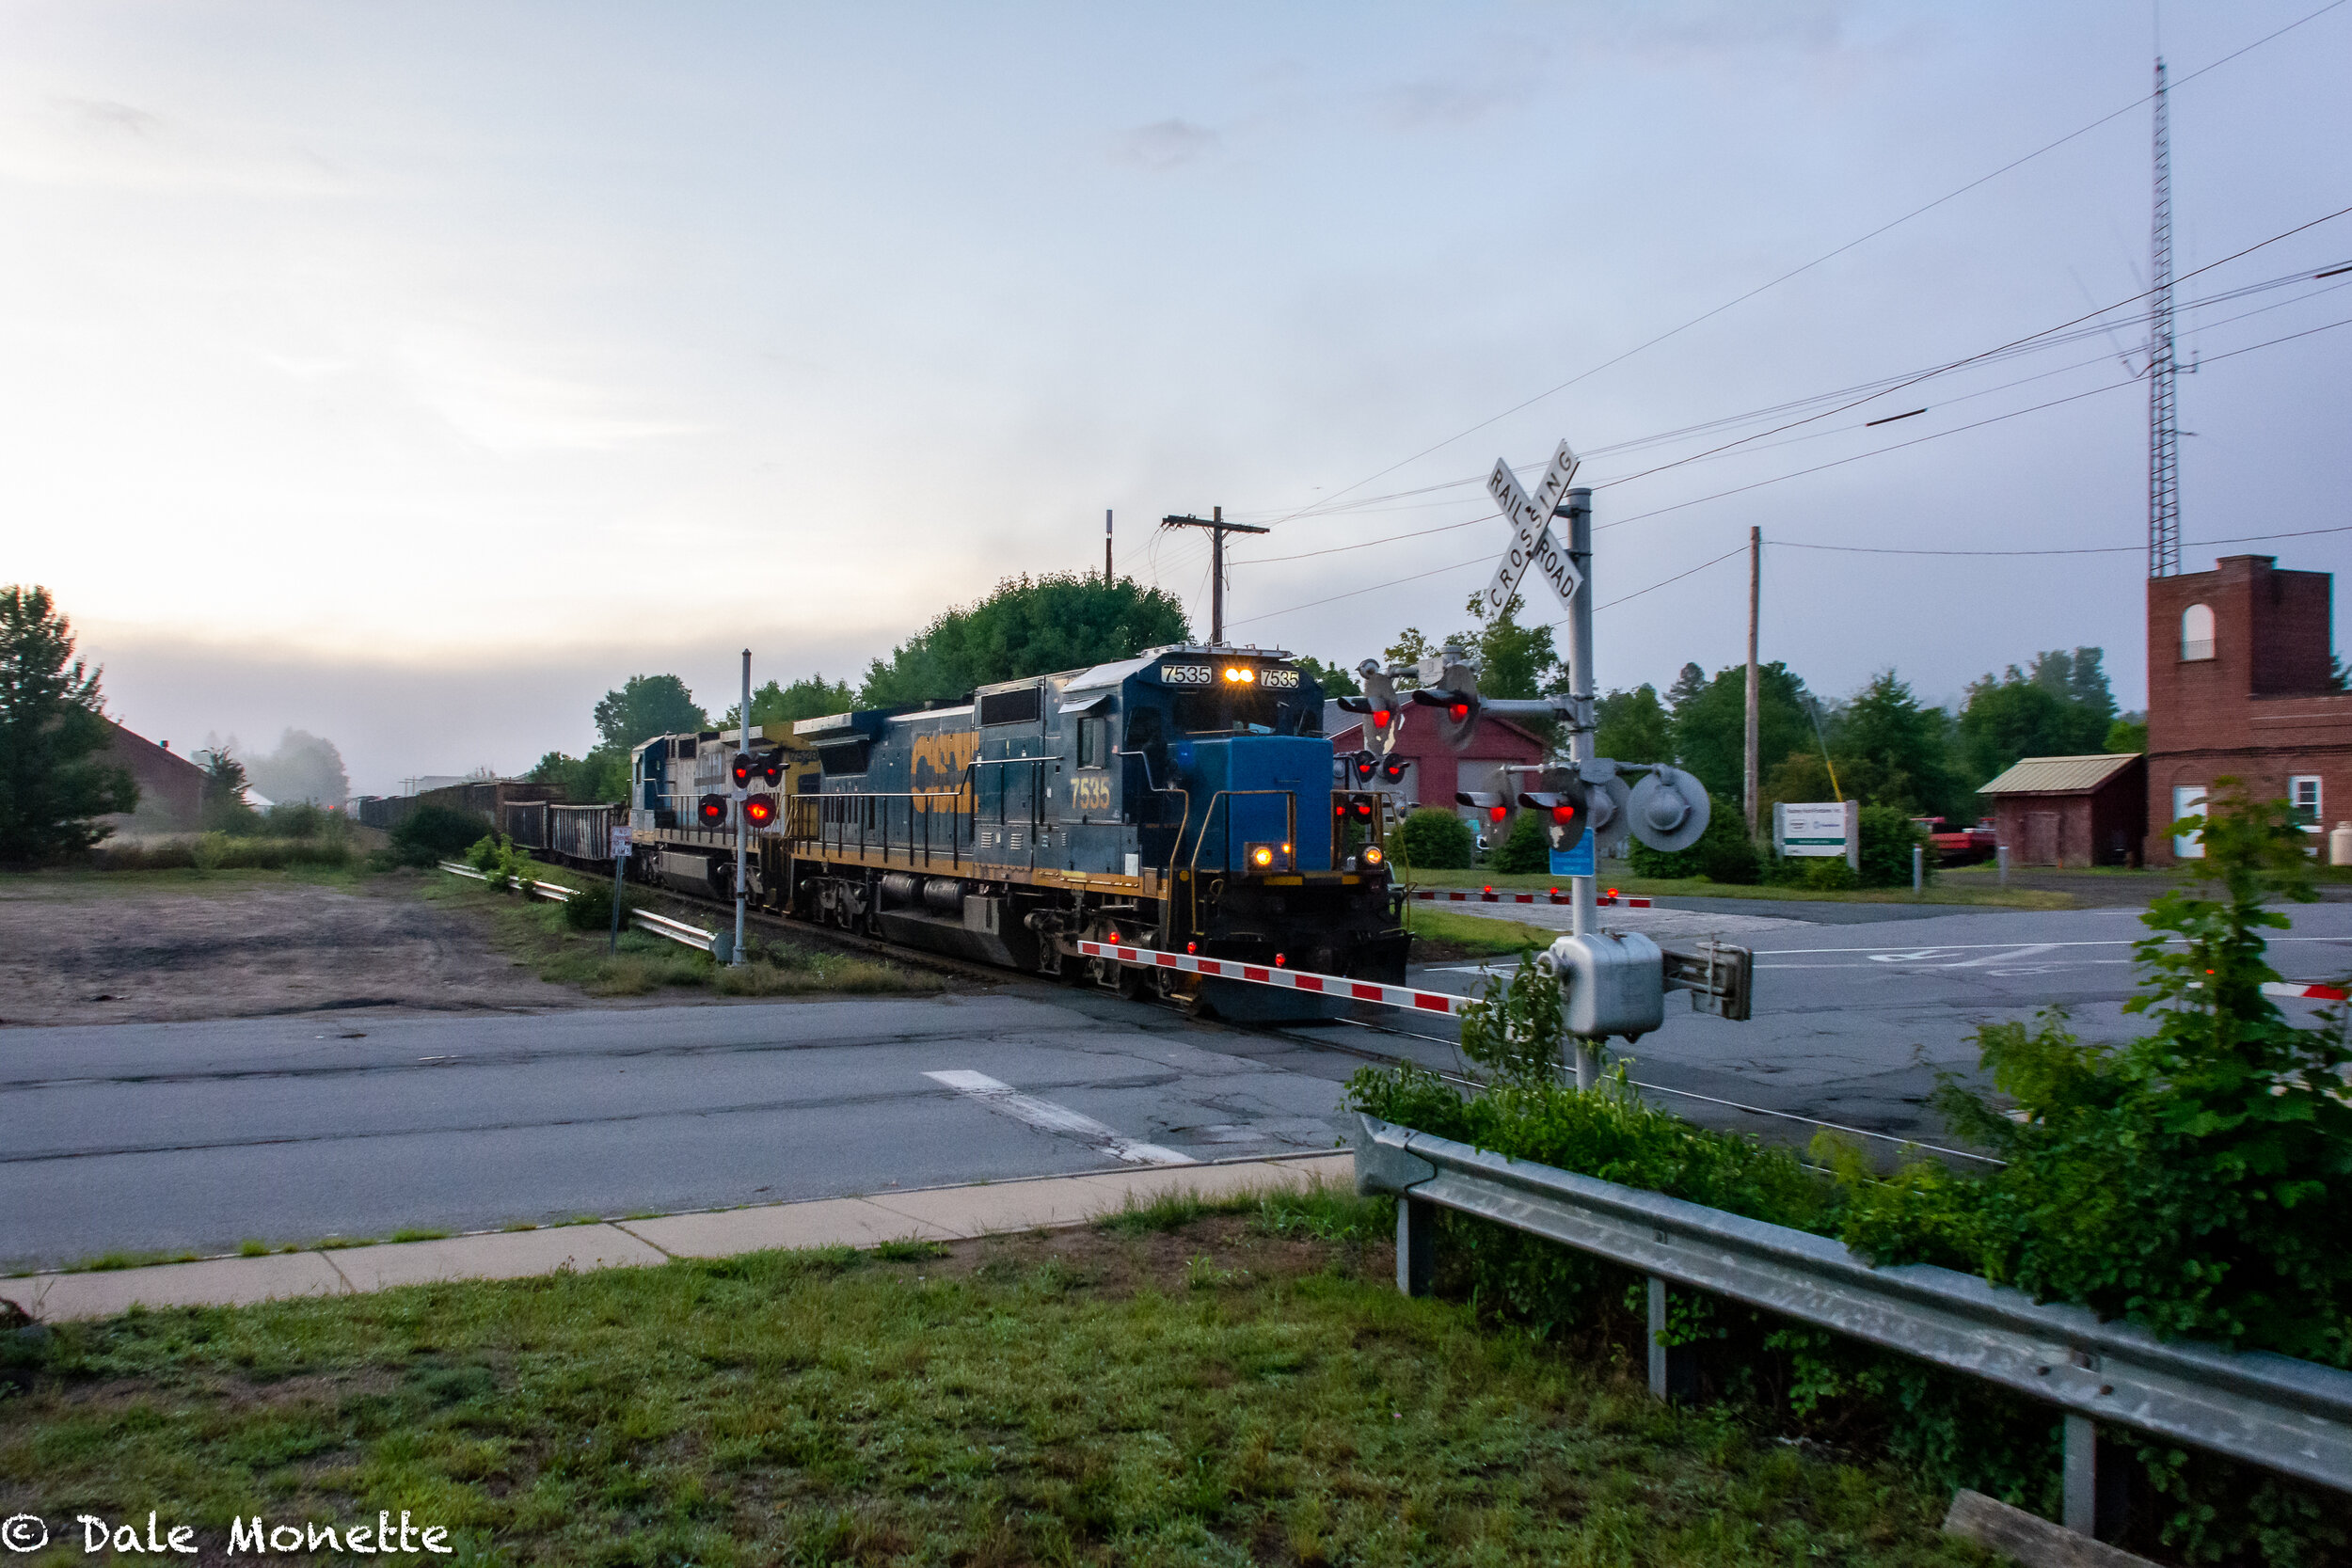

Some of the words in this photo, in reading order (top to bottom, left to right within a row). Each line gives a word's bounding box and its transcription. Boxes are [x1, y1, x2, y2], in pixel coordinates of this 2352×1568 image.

[1490, 451, 1571, 608] CROSSING
[1490, 468, 1523, 526] RAIL
[1536, 539, 1574, 598] ROAD
[1165, 665, 1211, 684] 7535
[1263, 670, 1299, 688] 7535
[1070, 776, 1111, 810] 7535
